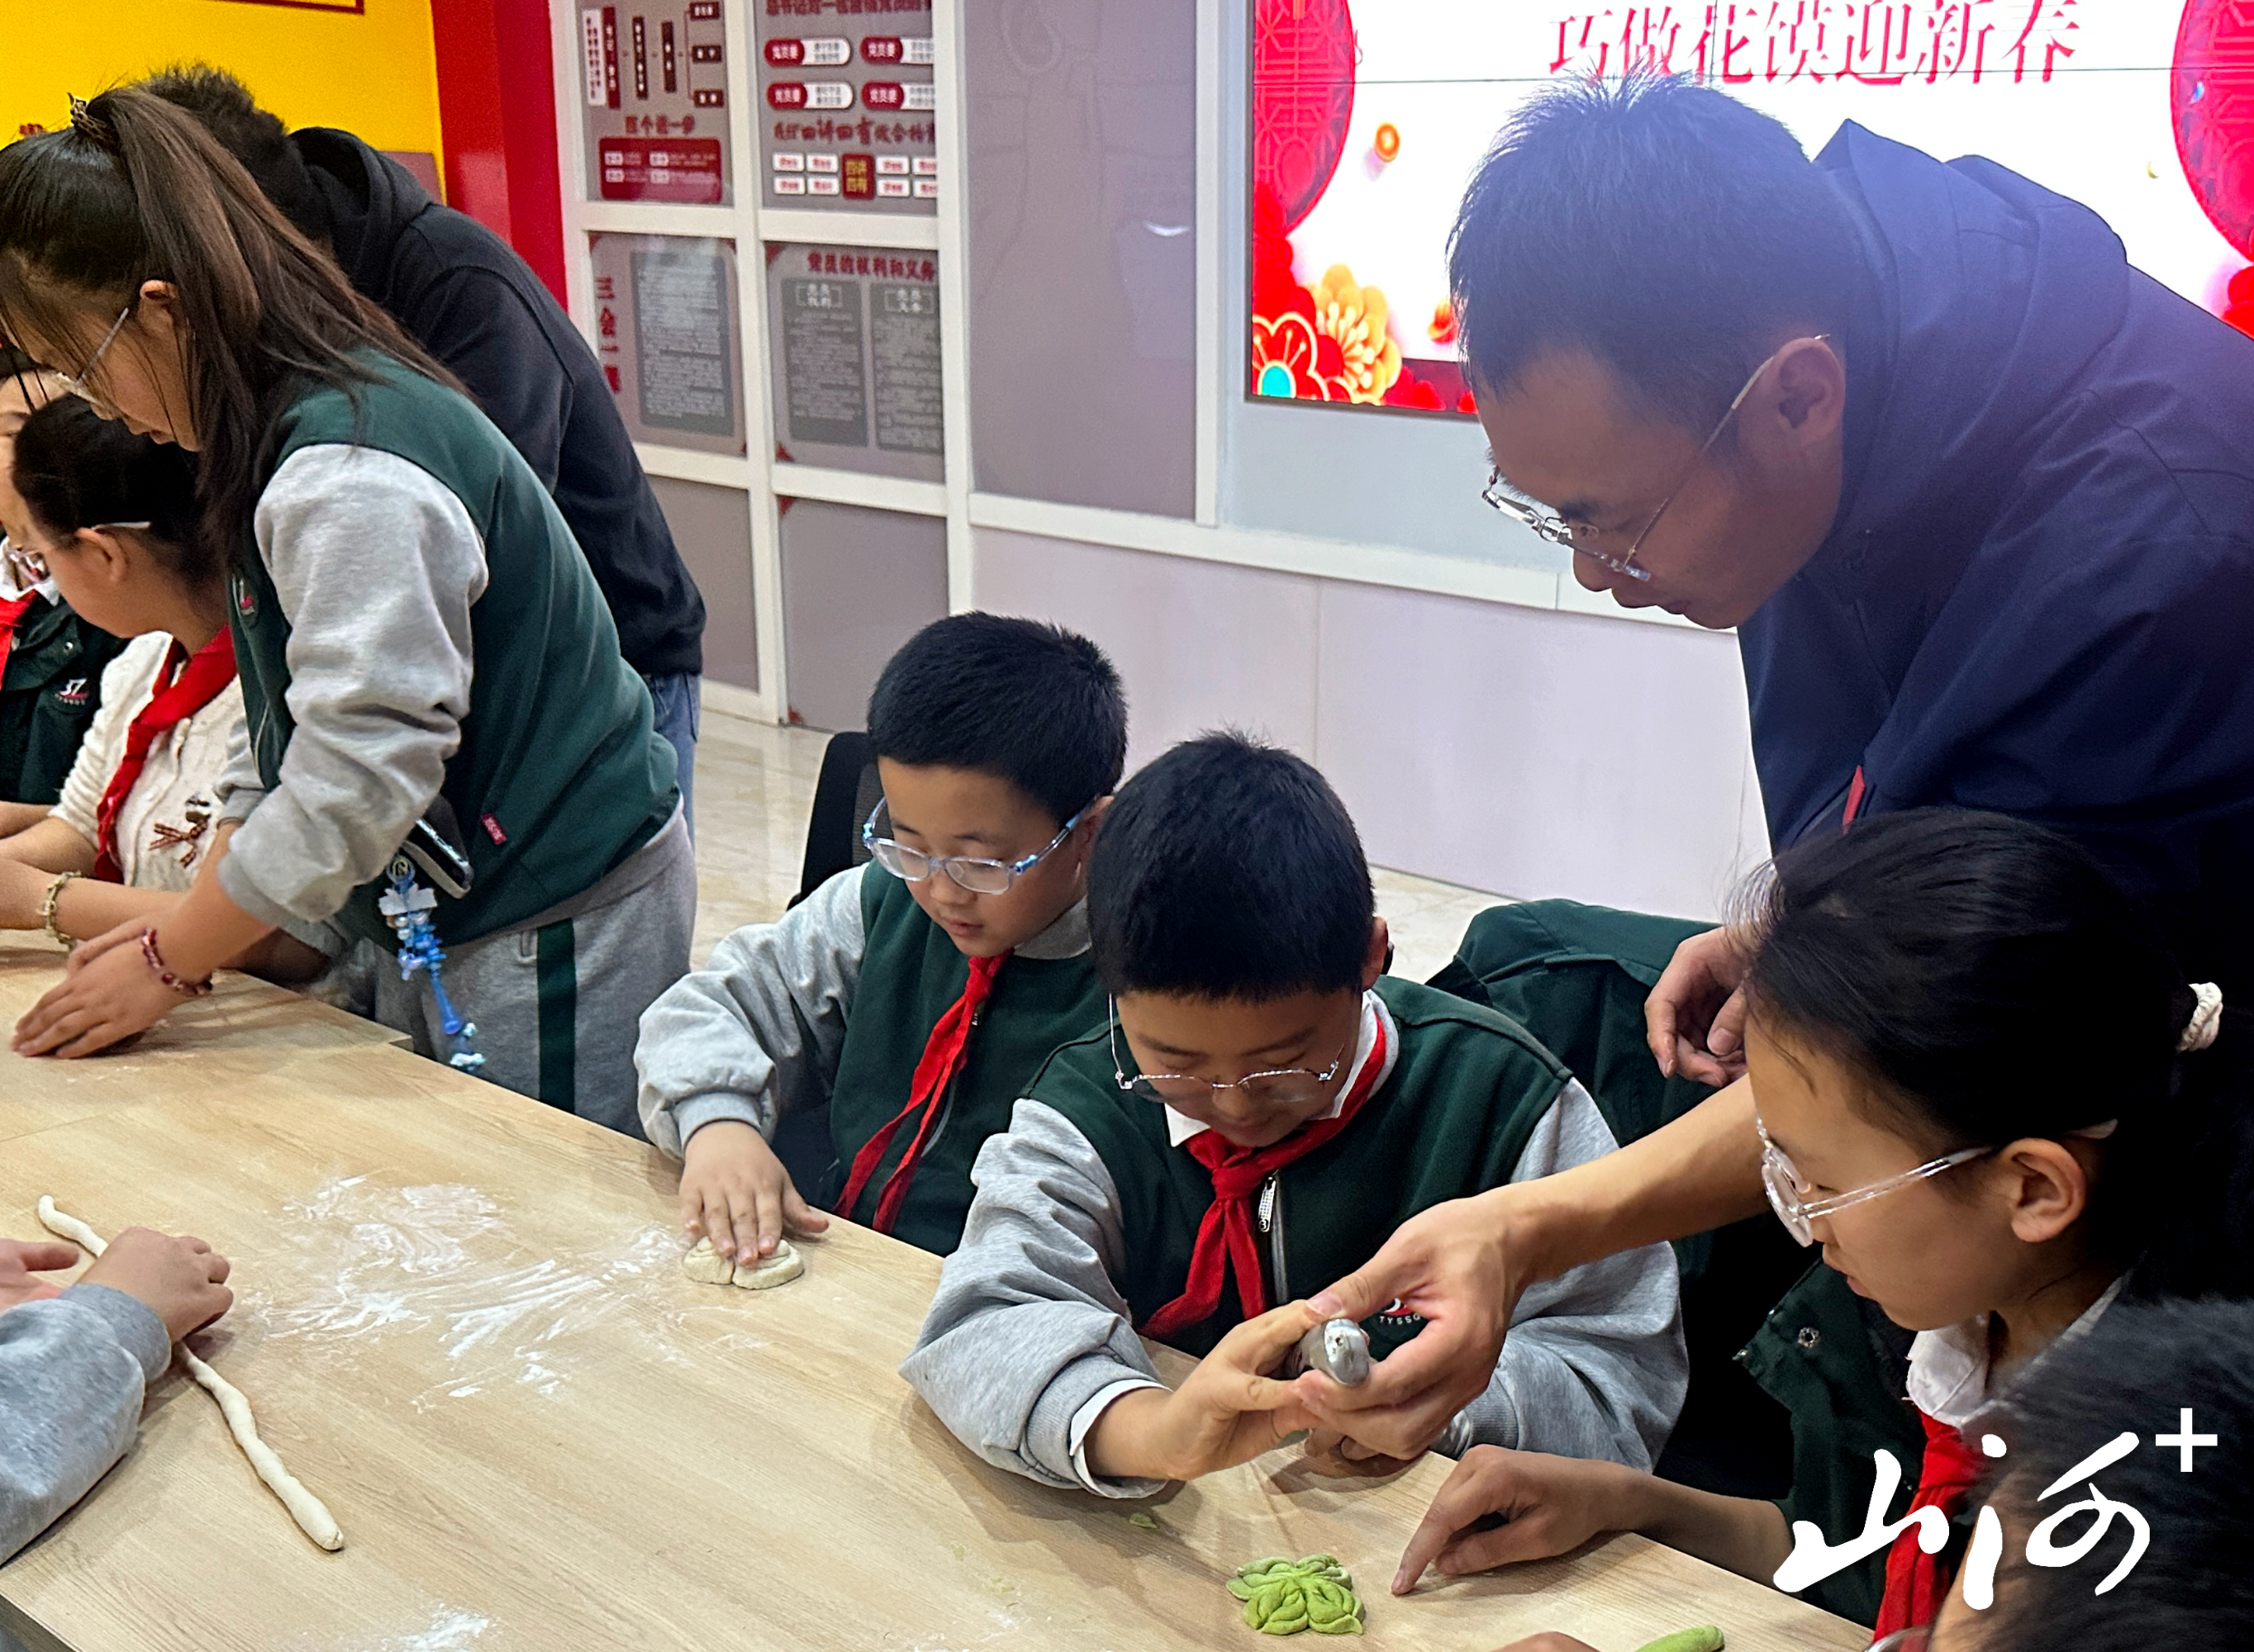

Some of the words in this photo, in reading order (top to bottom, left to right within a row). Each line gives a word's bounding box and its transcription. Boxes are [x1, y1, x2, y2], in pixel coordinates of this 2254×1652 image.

[1549, 0, 2080, 85] 巧做花馍迎新春
[807, 251, 934, 281] 党员的权利和义务
